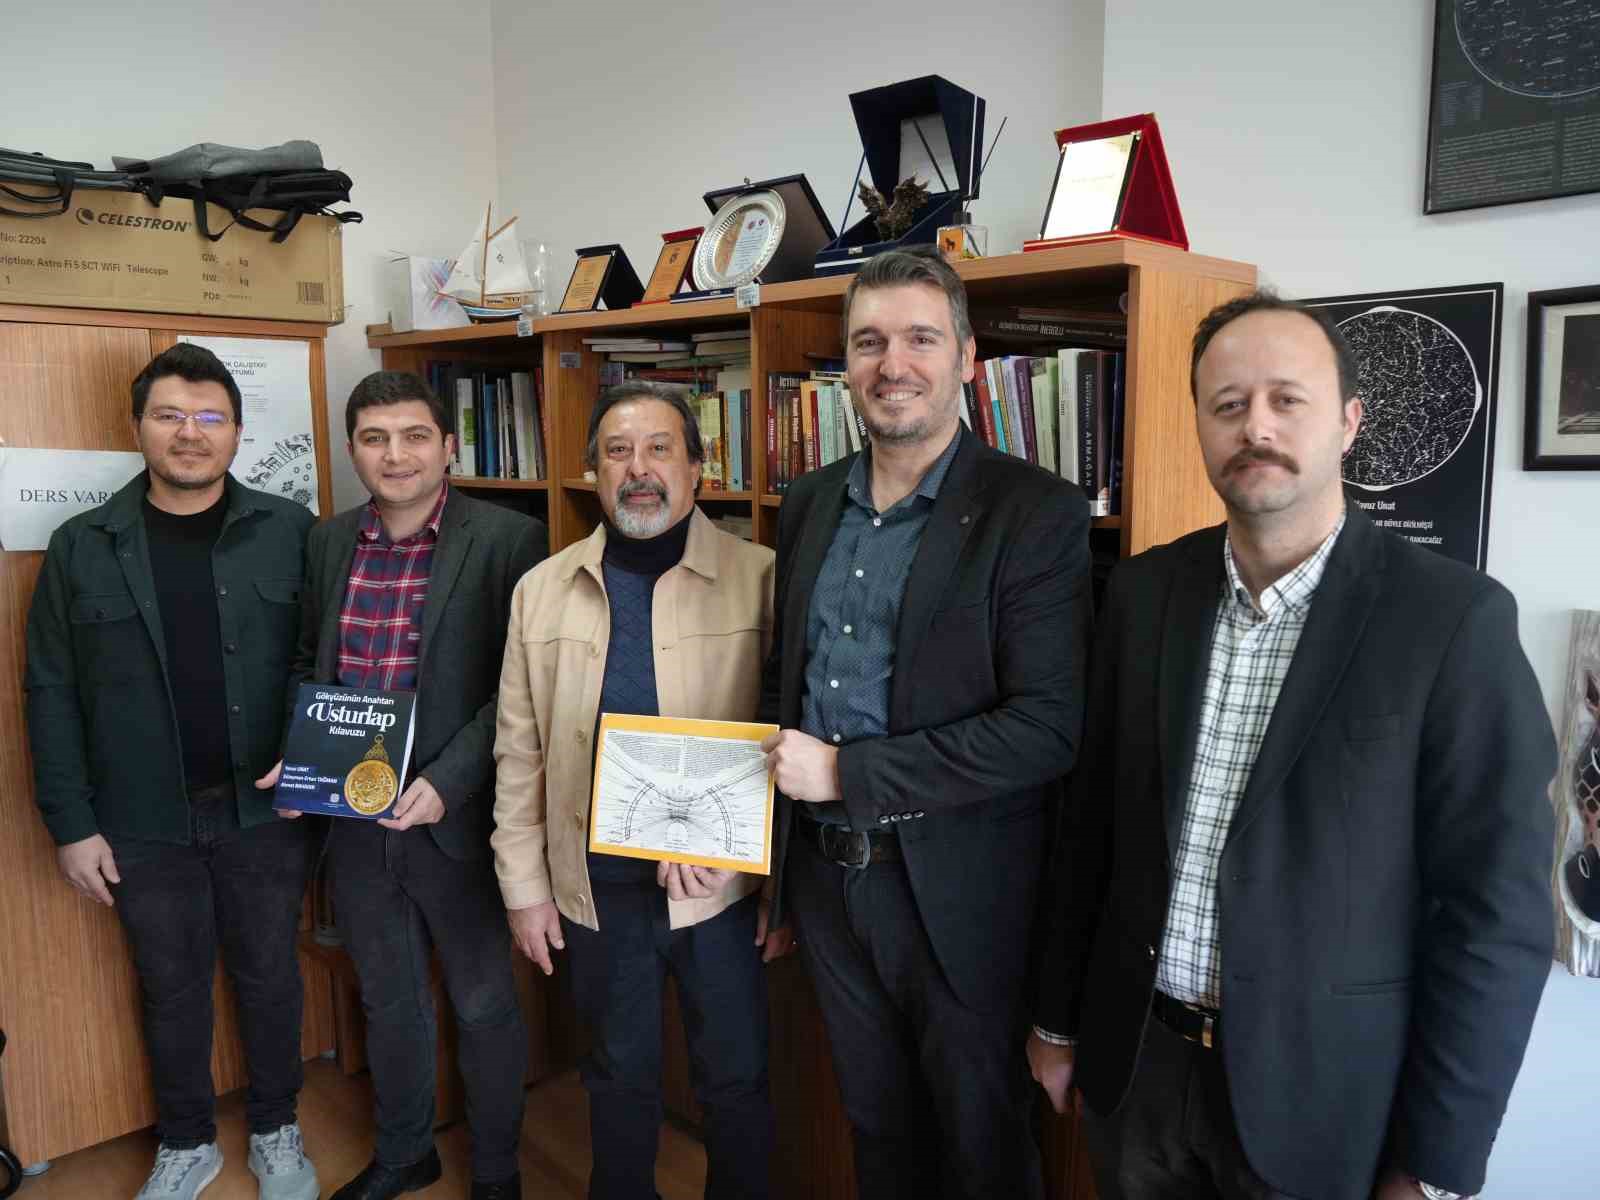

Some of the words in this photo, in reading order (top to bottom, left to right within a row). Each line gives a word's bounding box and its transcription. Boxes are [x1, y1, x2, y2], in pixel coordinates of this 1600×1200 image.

[97, 212, 187, 232] CELESTRON
[18, 234, 47, 245] 22204
[37, 258, 62, 268] Astro
[81, 261, 98, 271] SCT
[127, 264, 169, 276] Telescope
[20, 488, 68, 503] DERS
[73, 490, 115, 504] VAR
[1377, 500, 1396, 511] Unat
[315, 691, 362, 703] Gökyüzünün
[306, 702, 397, 733] Usturlap
[328, 725, 367, 737] Kılavuzu
